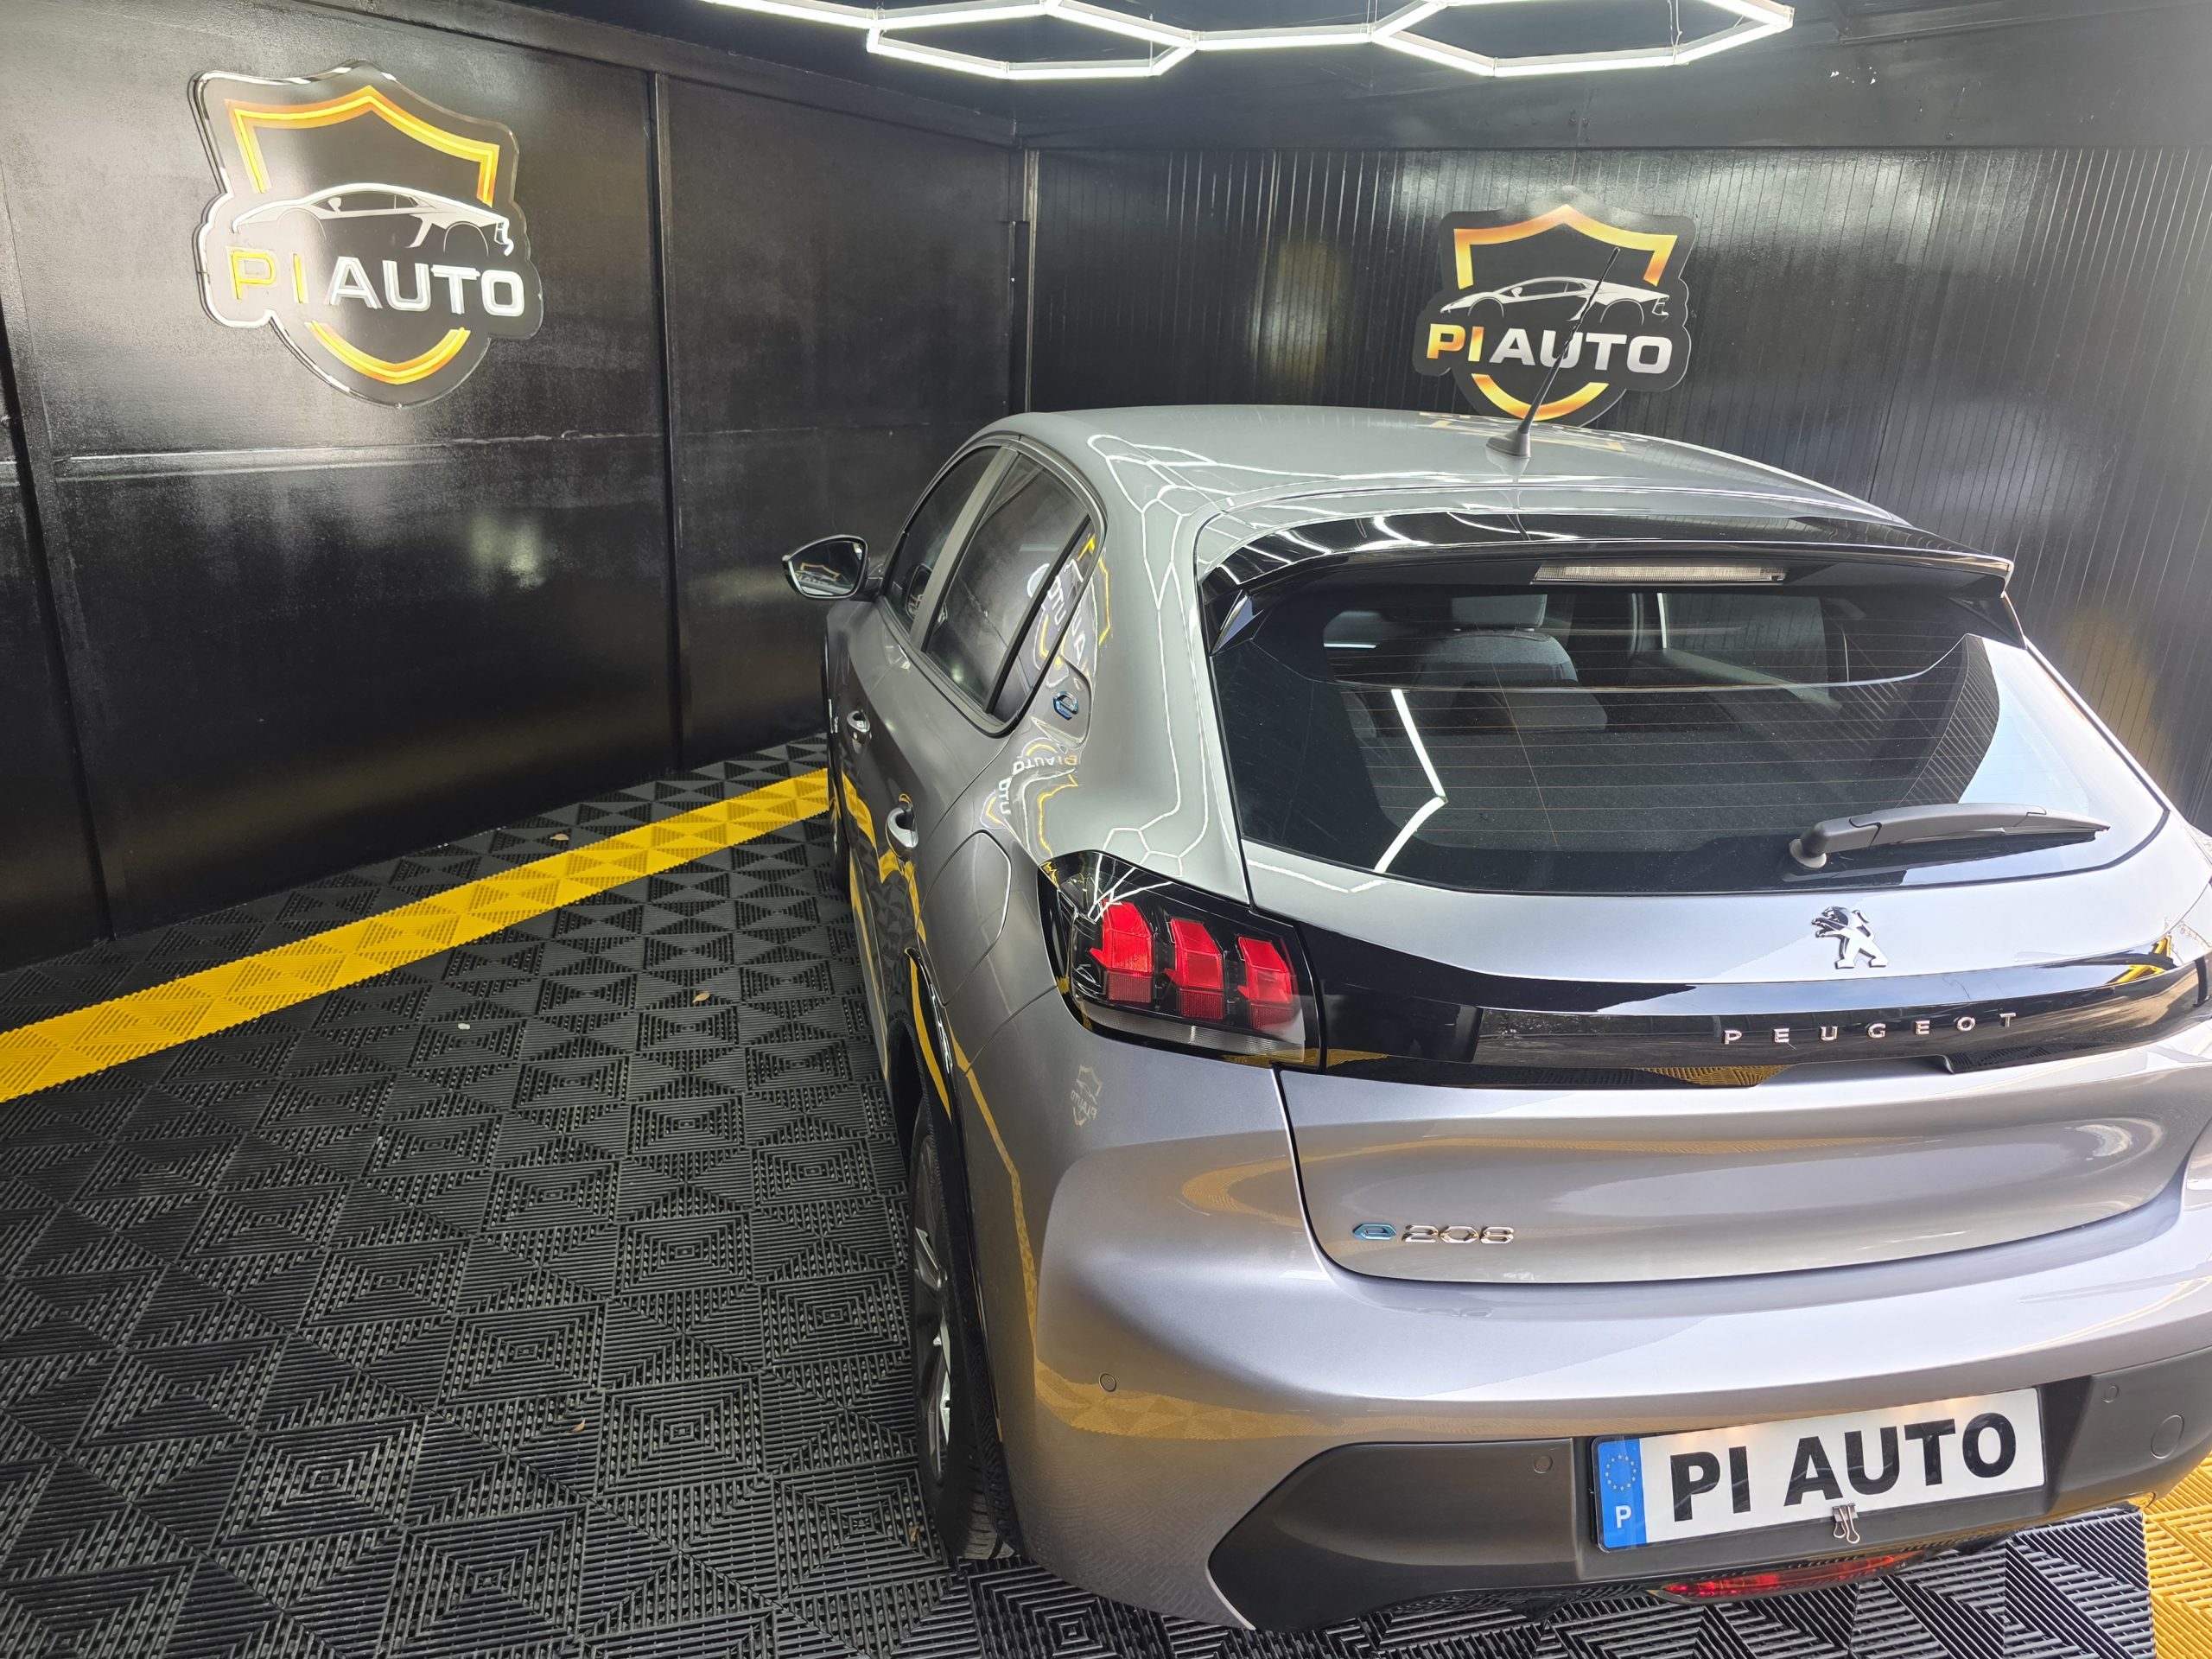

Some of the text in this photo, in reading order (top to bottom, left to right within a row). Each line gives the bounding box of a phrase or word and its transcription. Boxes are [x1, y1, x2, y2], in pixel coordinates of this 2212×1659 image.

[326, 256, 524, 317] AUTO
[1723, 1013, 2016, 1045] PEUGEOT
[1670, 1413, 2016, 1522] PI AUTO
[1615, 1505, 1631, 1529] P
